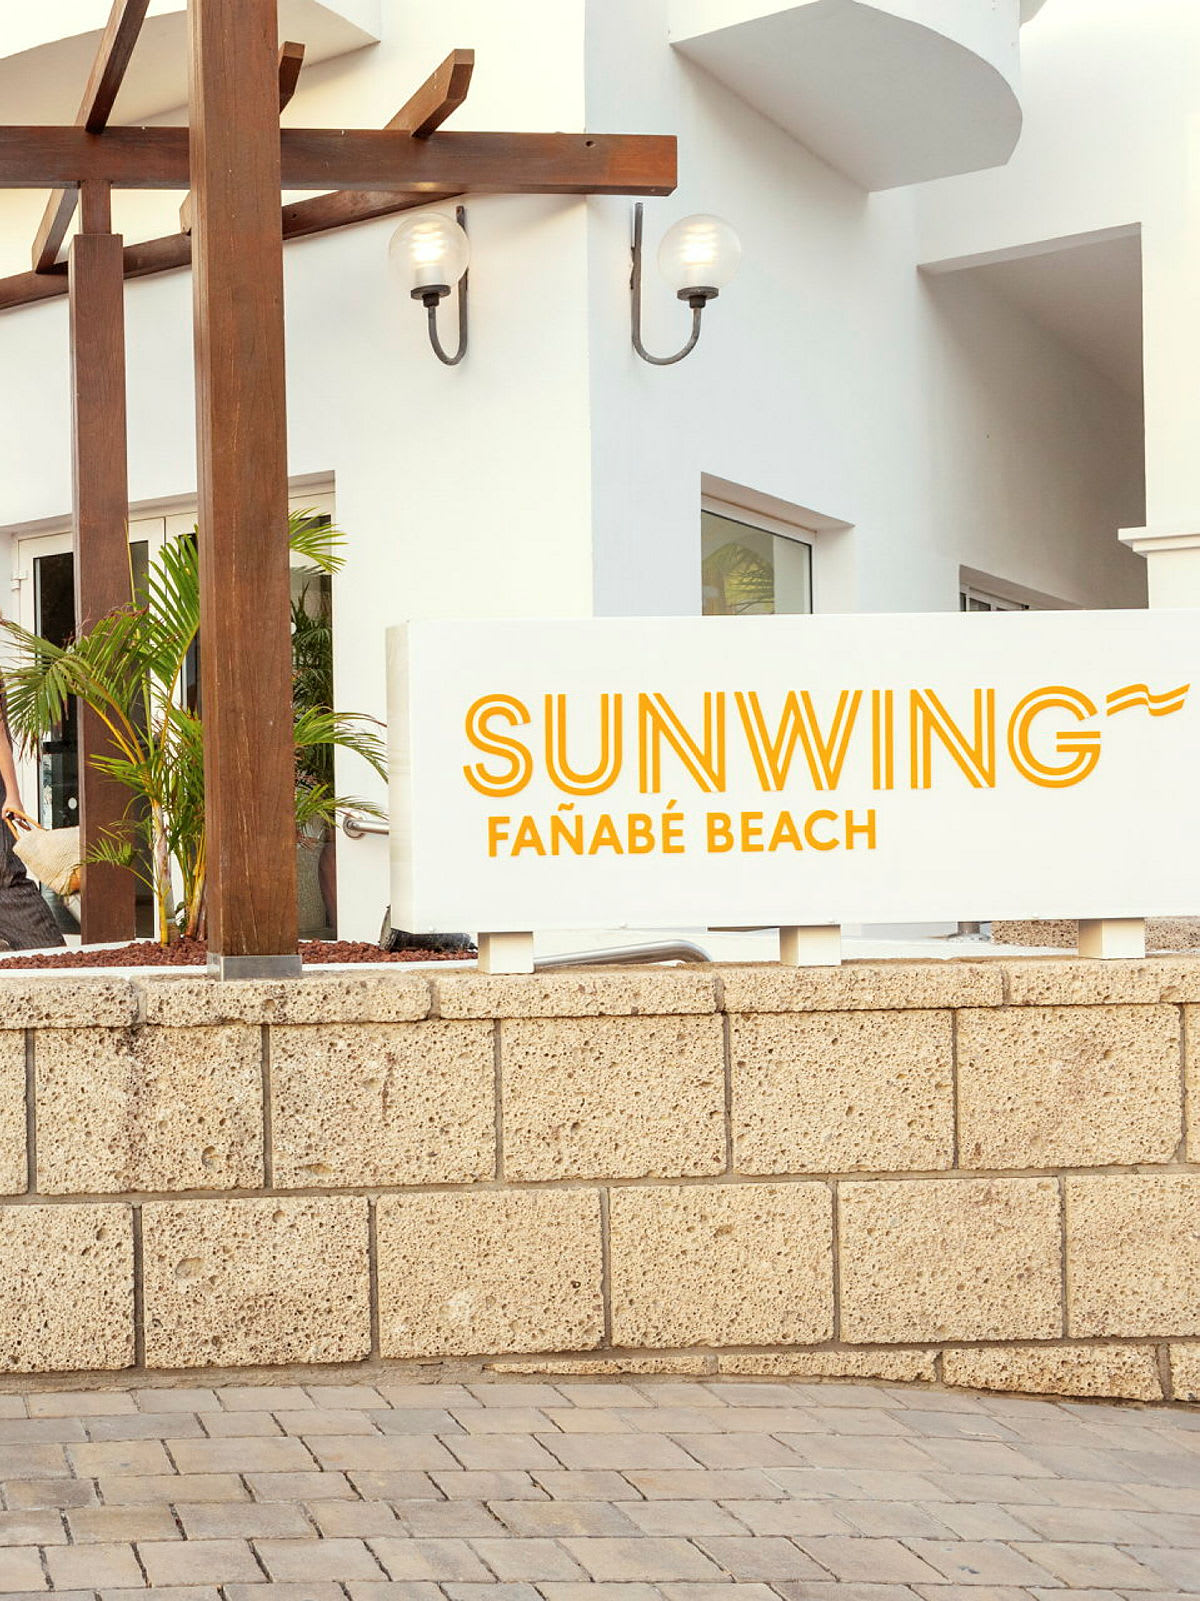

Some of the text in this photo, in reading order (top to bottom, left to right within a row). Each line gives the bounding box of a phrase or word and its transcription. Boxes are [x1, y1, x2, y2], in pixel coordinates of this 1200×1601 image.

[462, 685, 1101, 798] SUNWING
[487, 799, 877, 857] FAÑABÉ BEACH
